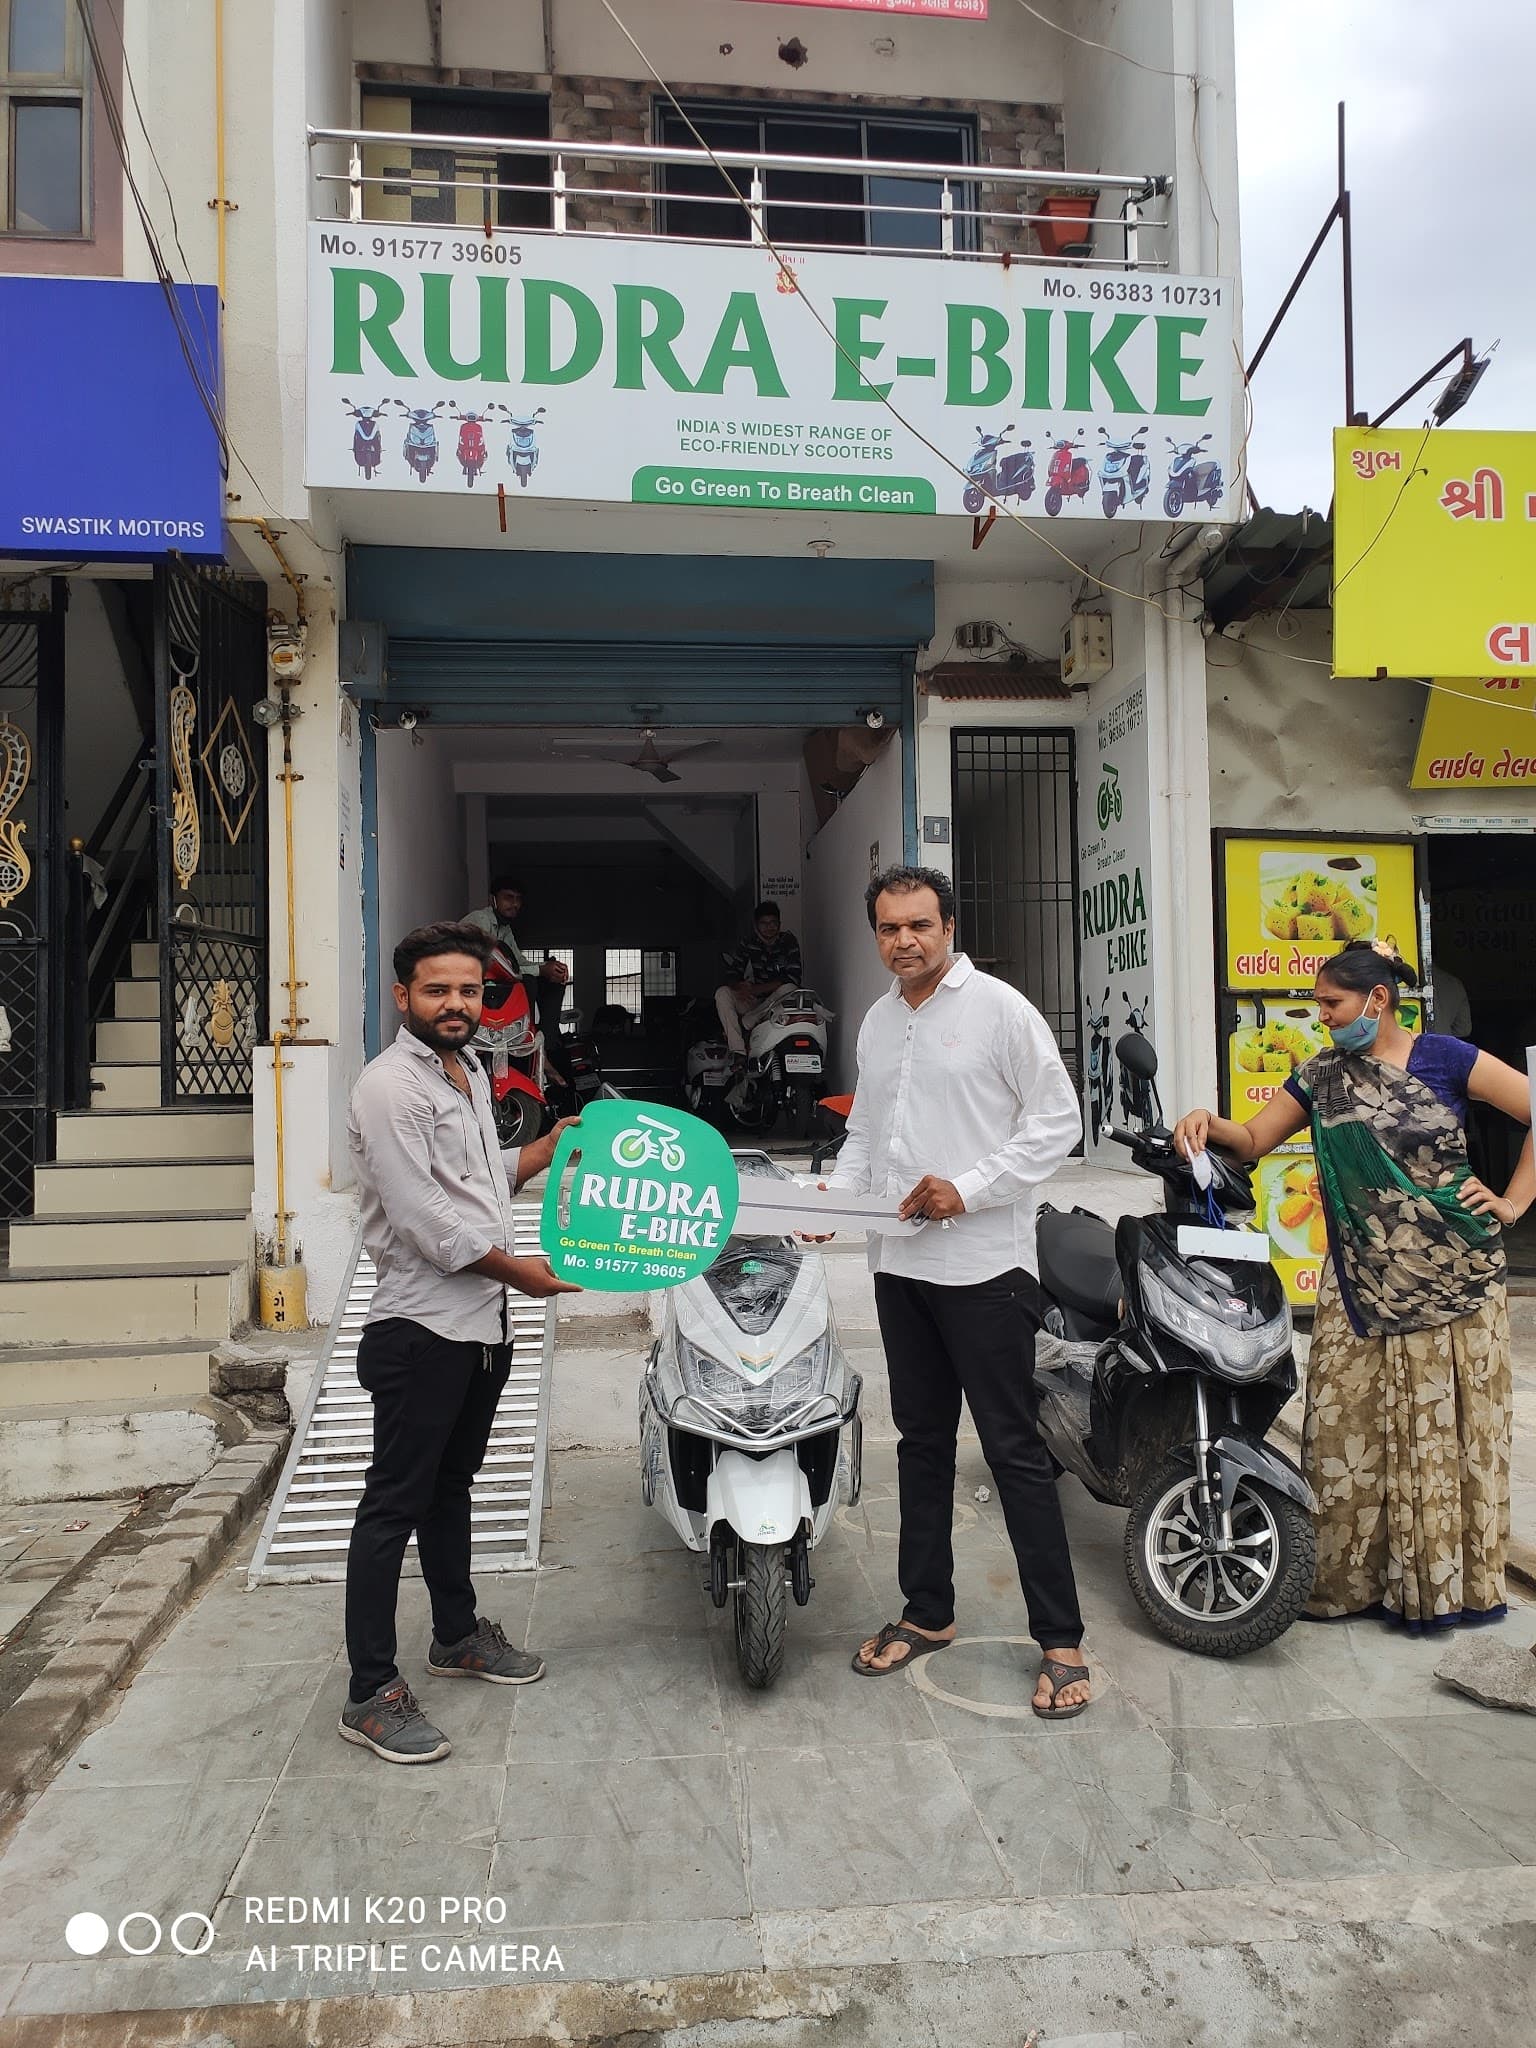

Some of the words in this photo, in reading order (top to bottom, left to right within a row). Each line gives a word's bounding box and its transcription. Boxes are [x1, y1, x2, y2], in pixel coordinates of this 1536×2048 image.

[320, 234, 363, 255] Mo.
[372, 237, 443, 260] 91577
[451, 242, 523, 265] 39605
[1043, 278, 1082, 298] Mo.
[1089, 281, 1154, 302] 96383
[1161, 285, 1222, 306] 10731
[329, 267, 790, 398] RUDRA
[831, 297, 1213, 416] E-BIKE
[741, 422, 804, 438] WIDEST
[809, 426, 866, 441] RANGE
[870, 428, 892, 442] OF
[680, 438, 799, 456] ECO-FRIENDLY
[804, 444, 893, 460] SCOOTERS
[1352, 450, 1401, 479] શુભ
[655, 476, 684, 495] Go
[690, 478, 750, 498] Green
[757, 481, 781, 499] To
[787, 482, 852, 502] Breath
[858, 486, 914, 504] Clean
[1440, 468, 1504, 519] શ્રી
[22, 517, 113, 536] SWASTIK
[118, 519, 205, 538] MOTORS
[1428, 752, 1485, 779] લાઈવ
[1082, 867, 1147, 940] RUDRA
[1107, 928, 1148, 974] E-BIKE
[1236, 949, 1280, 975] લાઈવ
[579, 1173, 723, 1219] RUDRA
[620, 1214, 720, 1248] E-BIKE
[560, 1237, 575, 1247] Go
[578, 1239, 610, 1252] Green
[614, 1242, 626, 1253] To
[629, 1245, 664, 1258] Breath
[666, 1248, 697, 1261] Clean
[563, 1254, 590, 1269] Mo.
[595, 1258, 638, 1274] 91577
[643, 1263, 686, 1279] 39605
